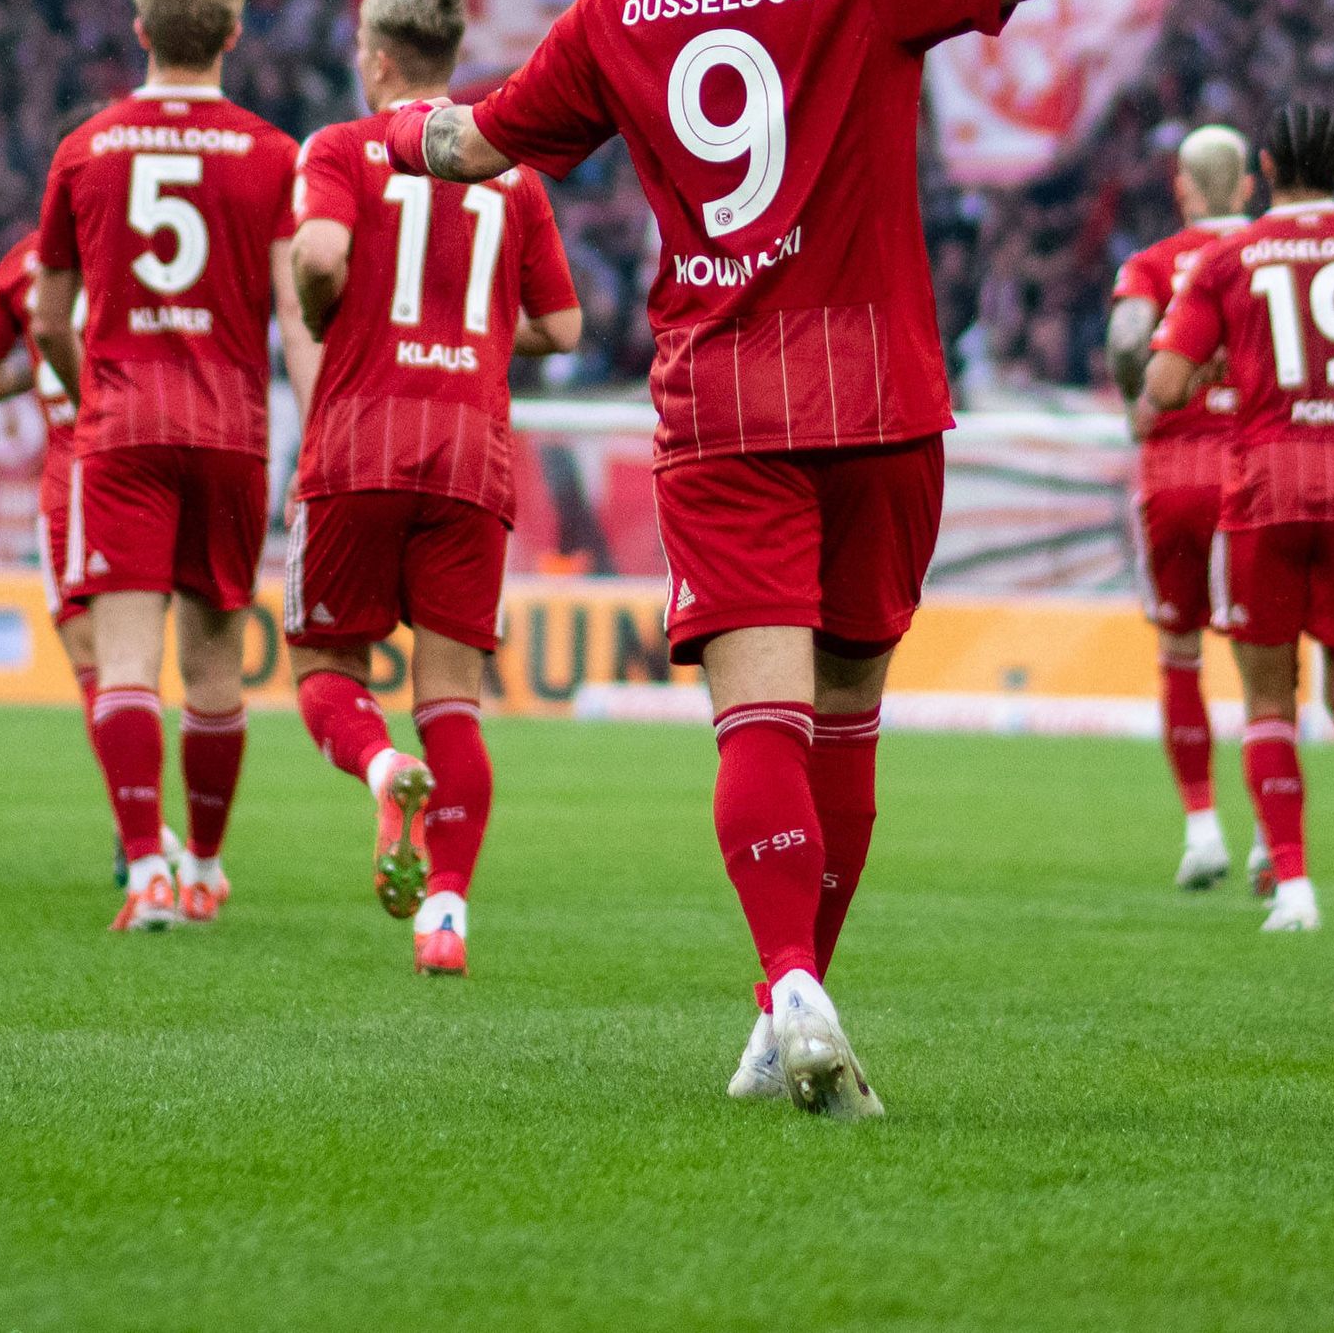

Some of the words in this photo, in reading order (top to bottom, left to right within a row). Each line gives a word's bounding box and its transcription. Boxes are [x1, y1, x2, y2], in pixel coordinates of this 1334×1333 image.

[668, 29, 787, 237] 9
[128, 153, 209, 295] 5
[384, 173, 505, 334] 11
[396, 341, 478, 371] KLAUS
[751, 829, 806, 861] F95
